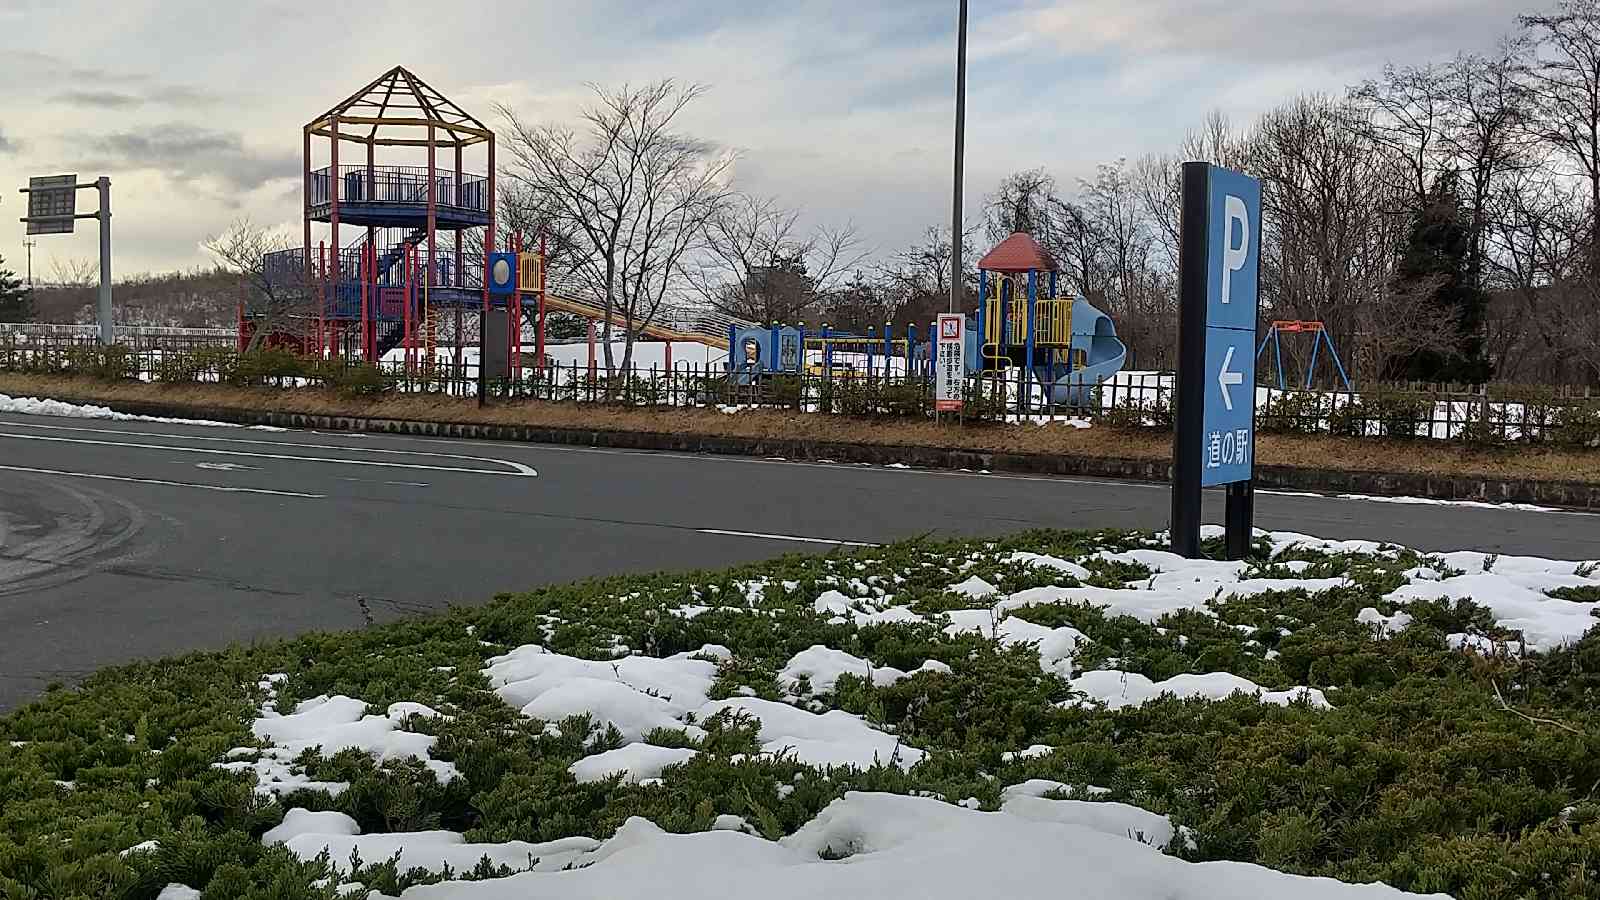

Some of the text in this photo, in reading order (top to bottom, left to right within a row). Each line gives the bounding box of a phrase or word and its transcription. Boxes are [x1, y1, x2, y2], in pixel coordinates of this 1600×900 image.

[1221, 195, 1250, 304] P
[1207, 429, 1249, 469] 道の駅
